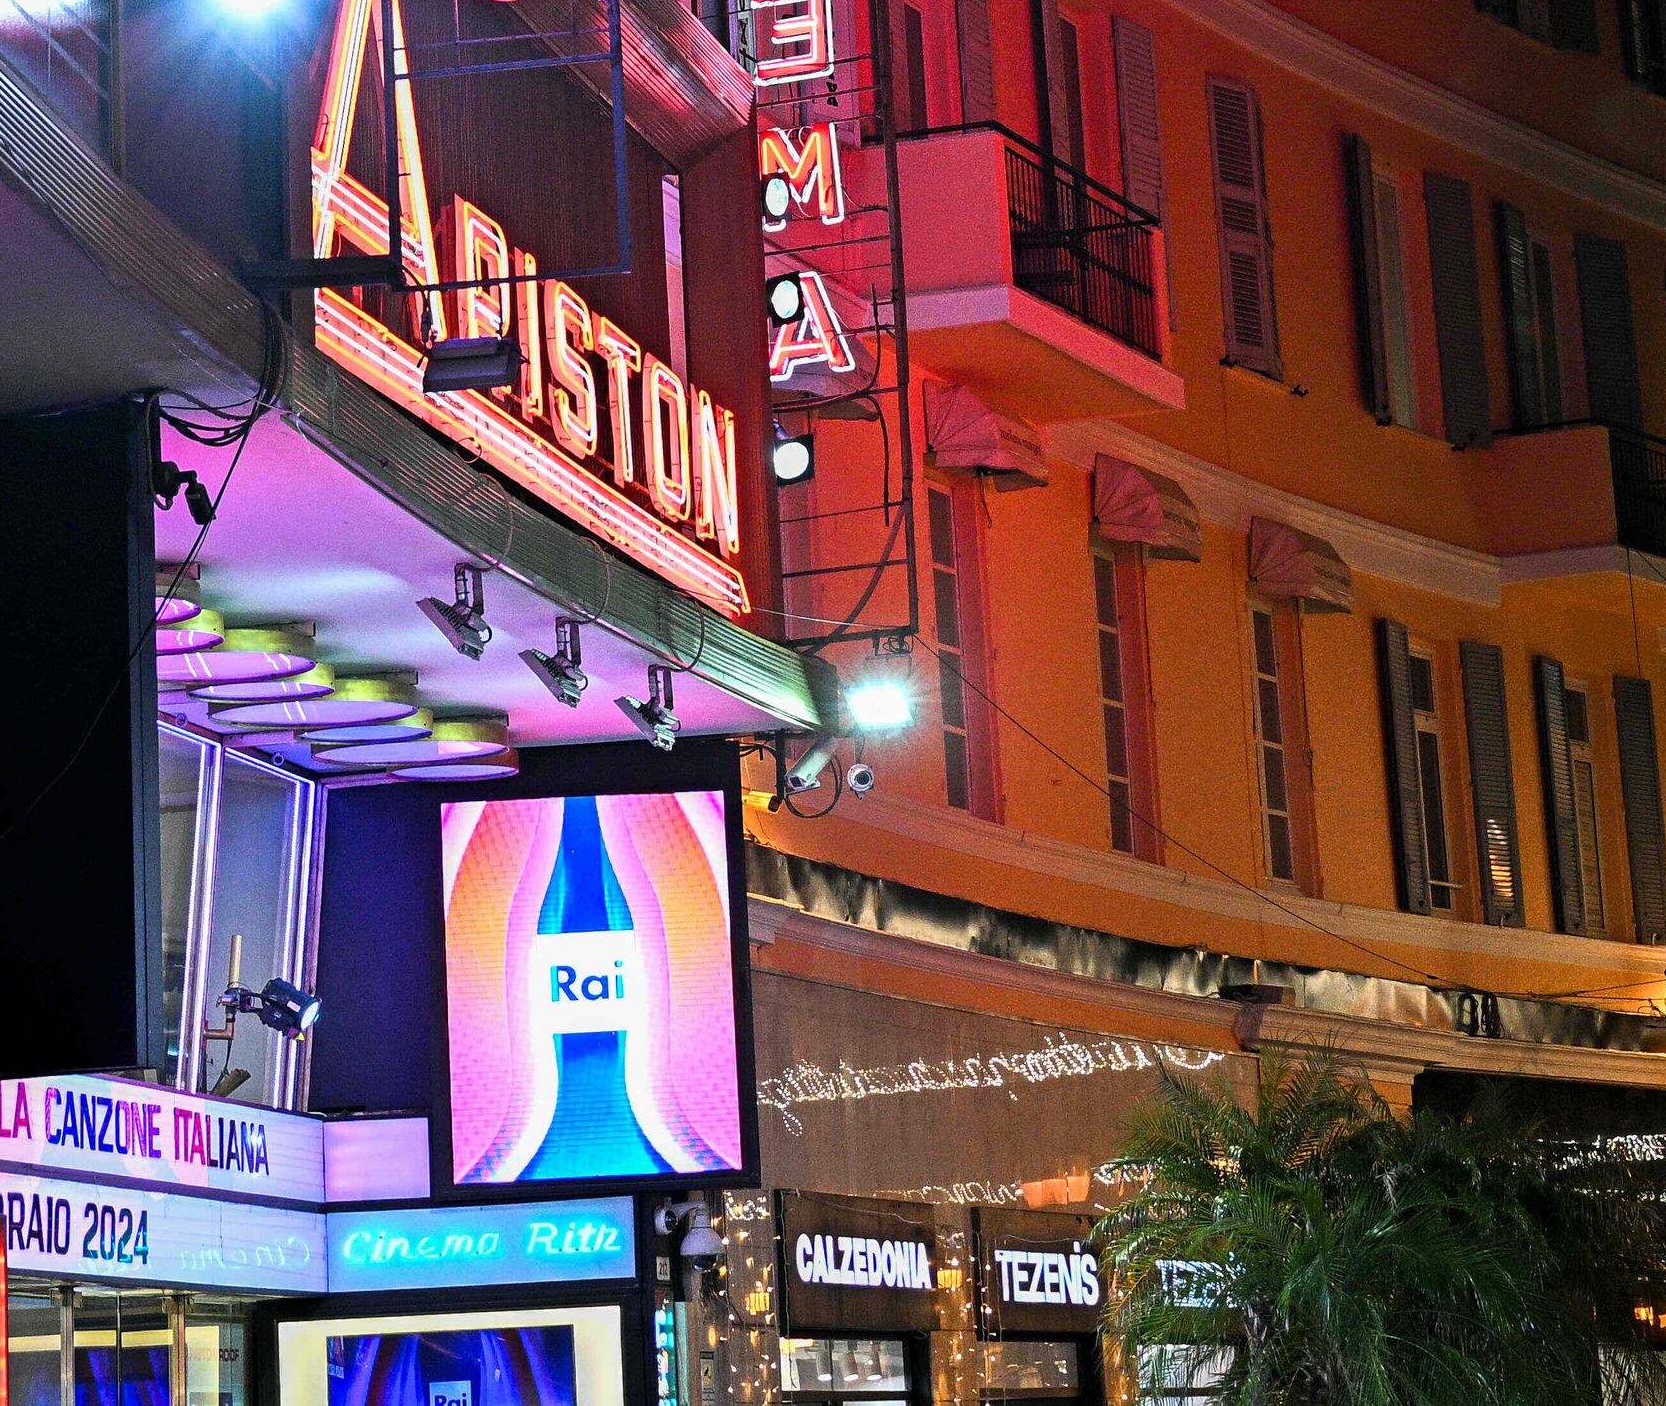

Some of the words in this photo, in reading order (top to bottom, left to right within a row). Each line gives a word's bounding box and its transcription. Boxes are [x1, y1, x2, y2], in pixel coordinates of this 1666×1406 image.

[550, 960, 624, 1002] Rai
[44, 1087, 162, 1158] CANZONE
[173, 1106, 270, 1176] ITALIANA
[82, 1202, 150, 1265] 2024
[344, 1230, 501, 1264] Cinema
[796, 1233, 932, 1289] CALZEDONIA
[994, 1241, 1100, 1305] TEZENIS
